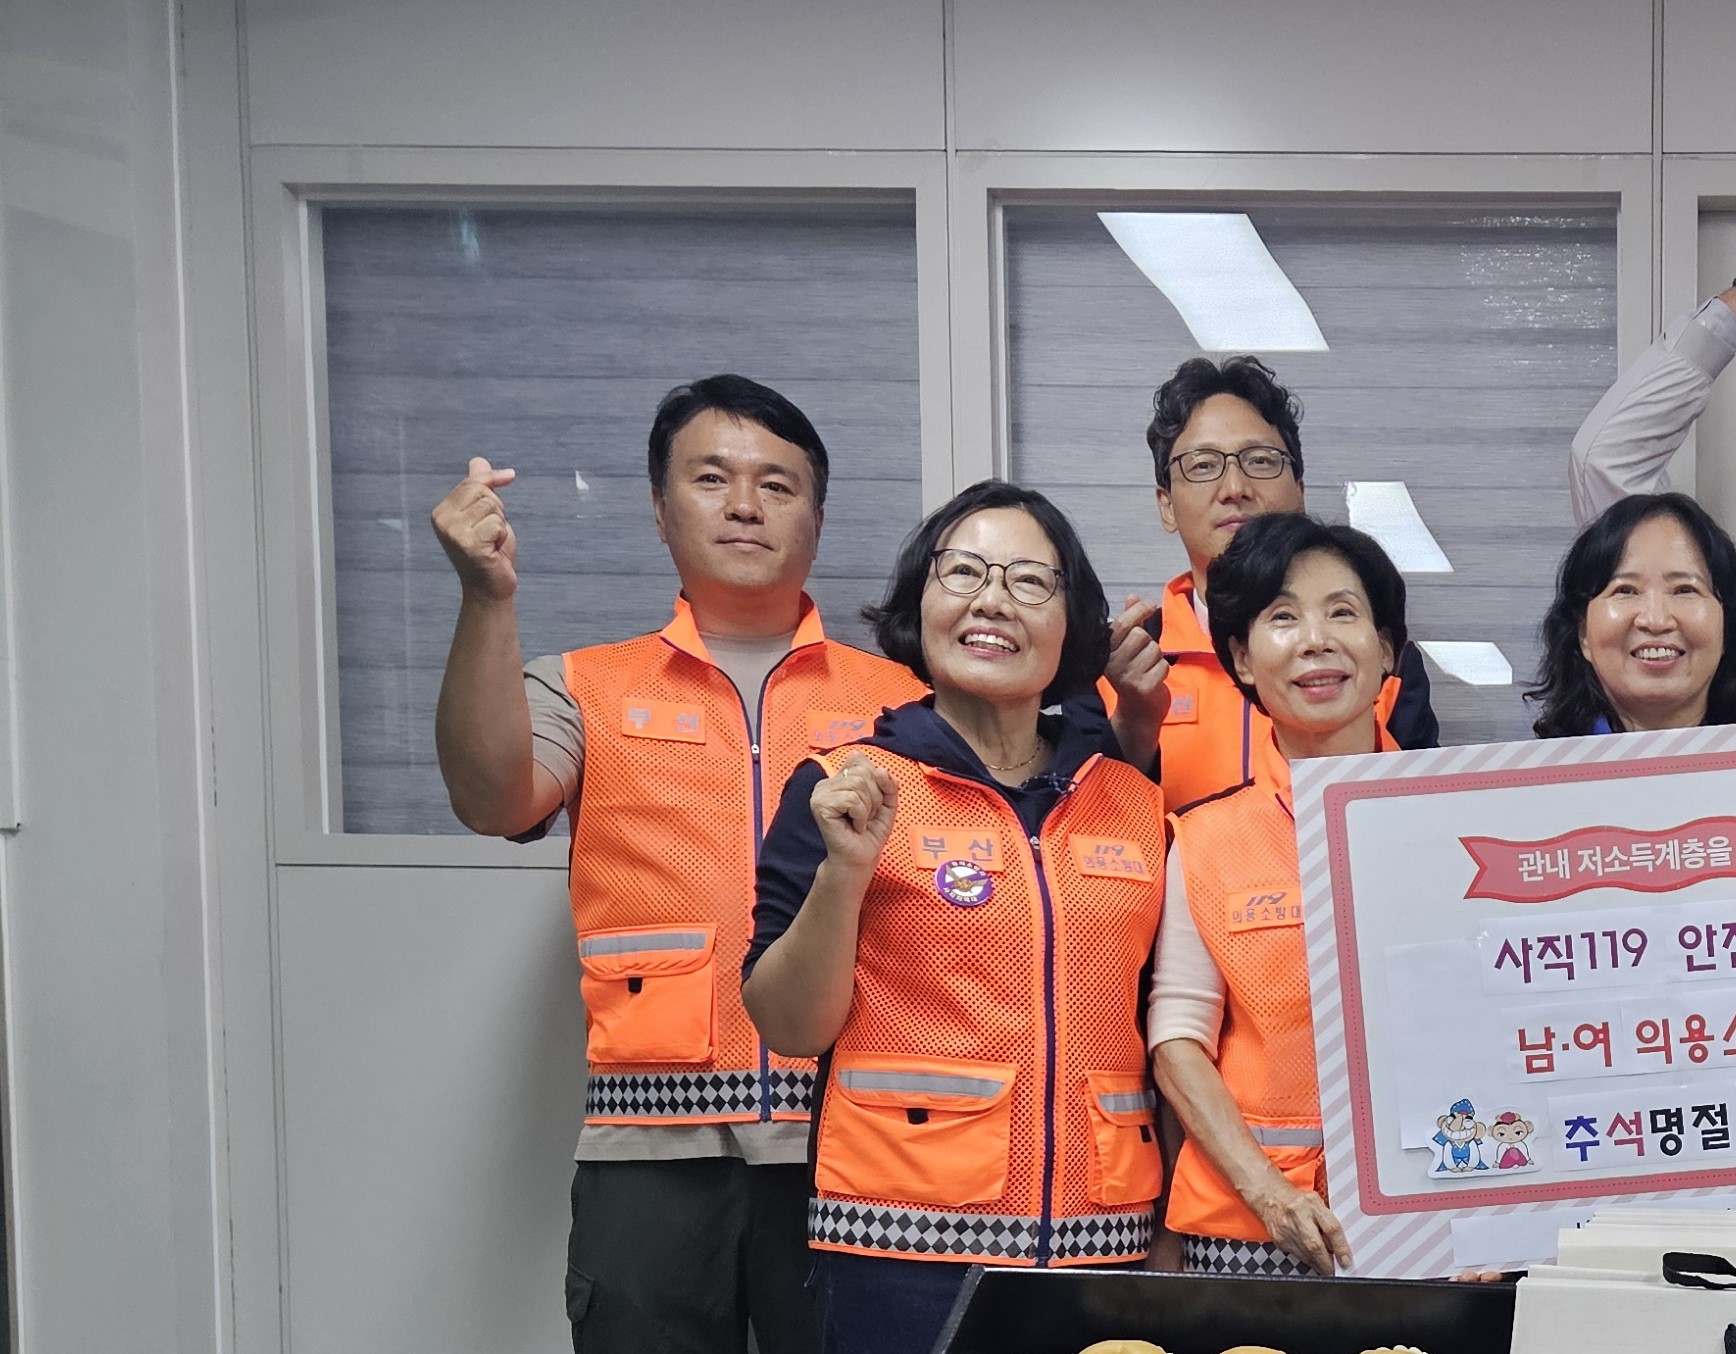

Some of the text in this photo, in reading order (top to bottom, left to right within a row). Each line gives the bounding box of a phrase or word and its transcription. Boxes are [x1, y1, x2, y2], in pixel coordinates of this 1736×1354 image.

[1518, 848, 1571, 883] 관내
[1577, 834, 1733, 877] 저소득계층을
[1494, 928, 1648, 984] 사직119
[1564, 1103, 1731, 1162] 추석명절
